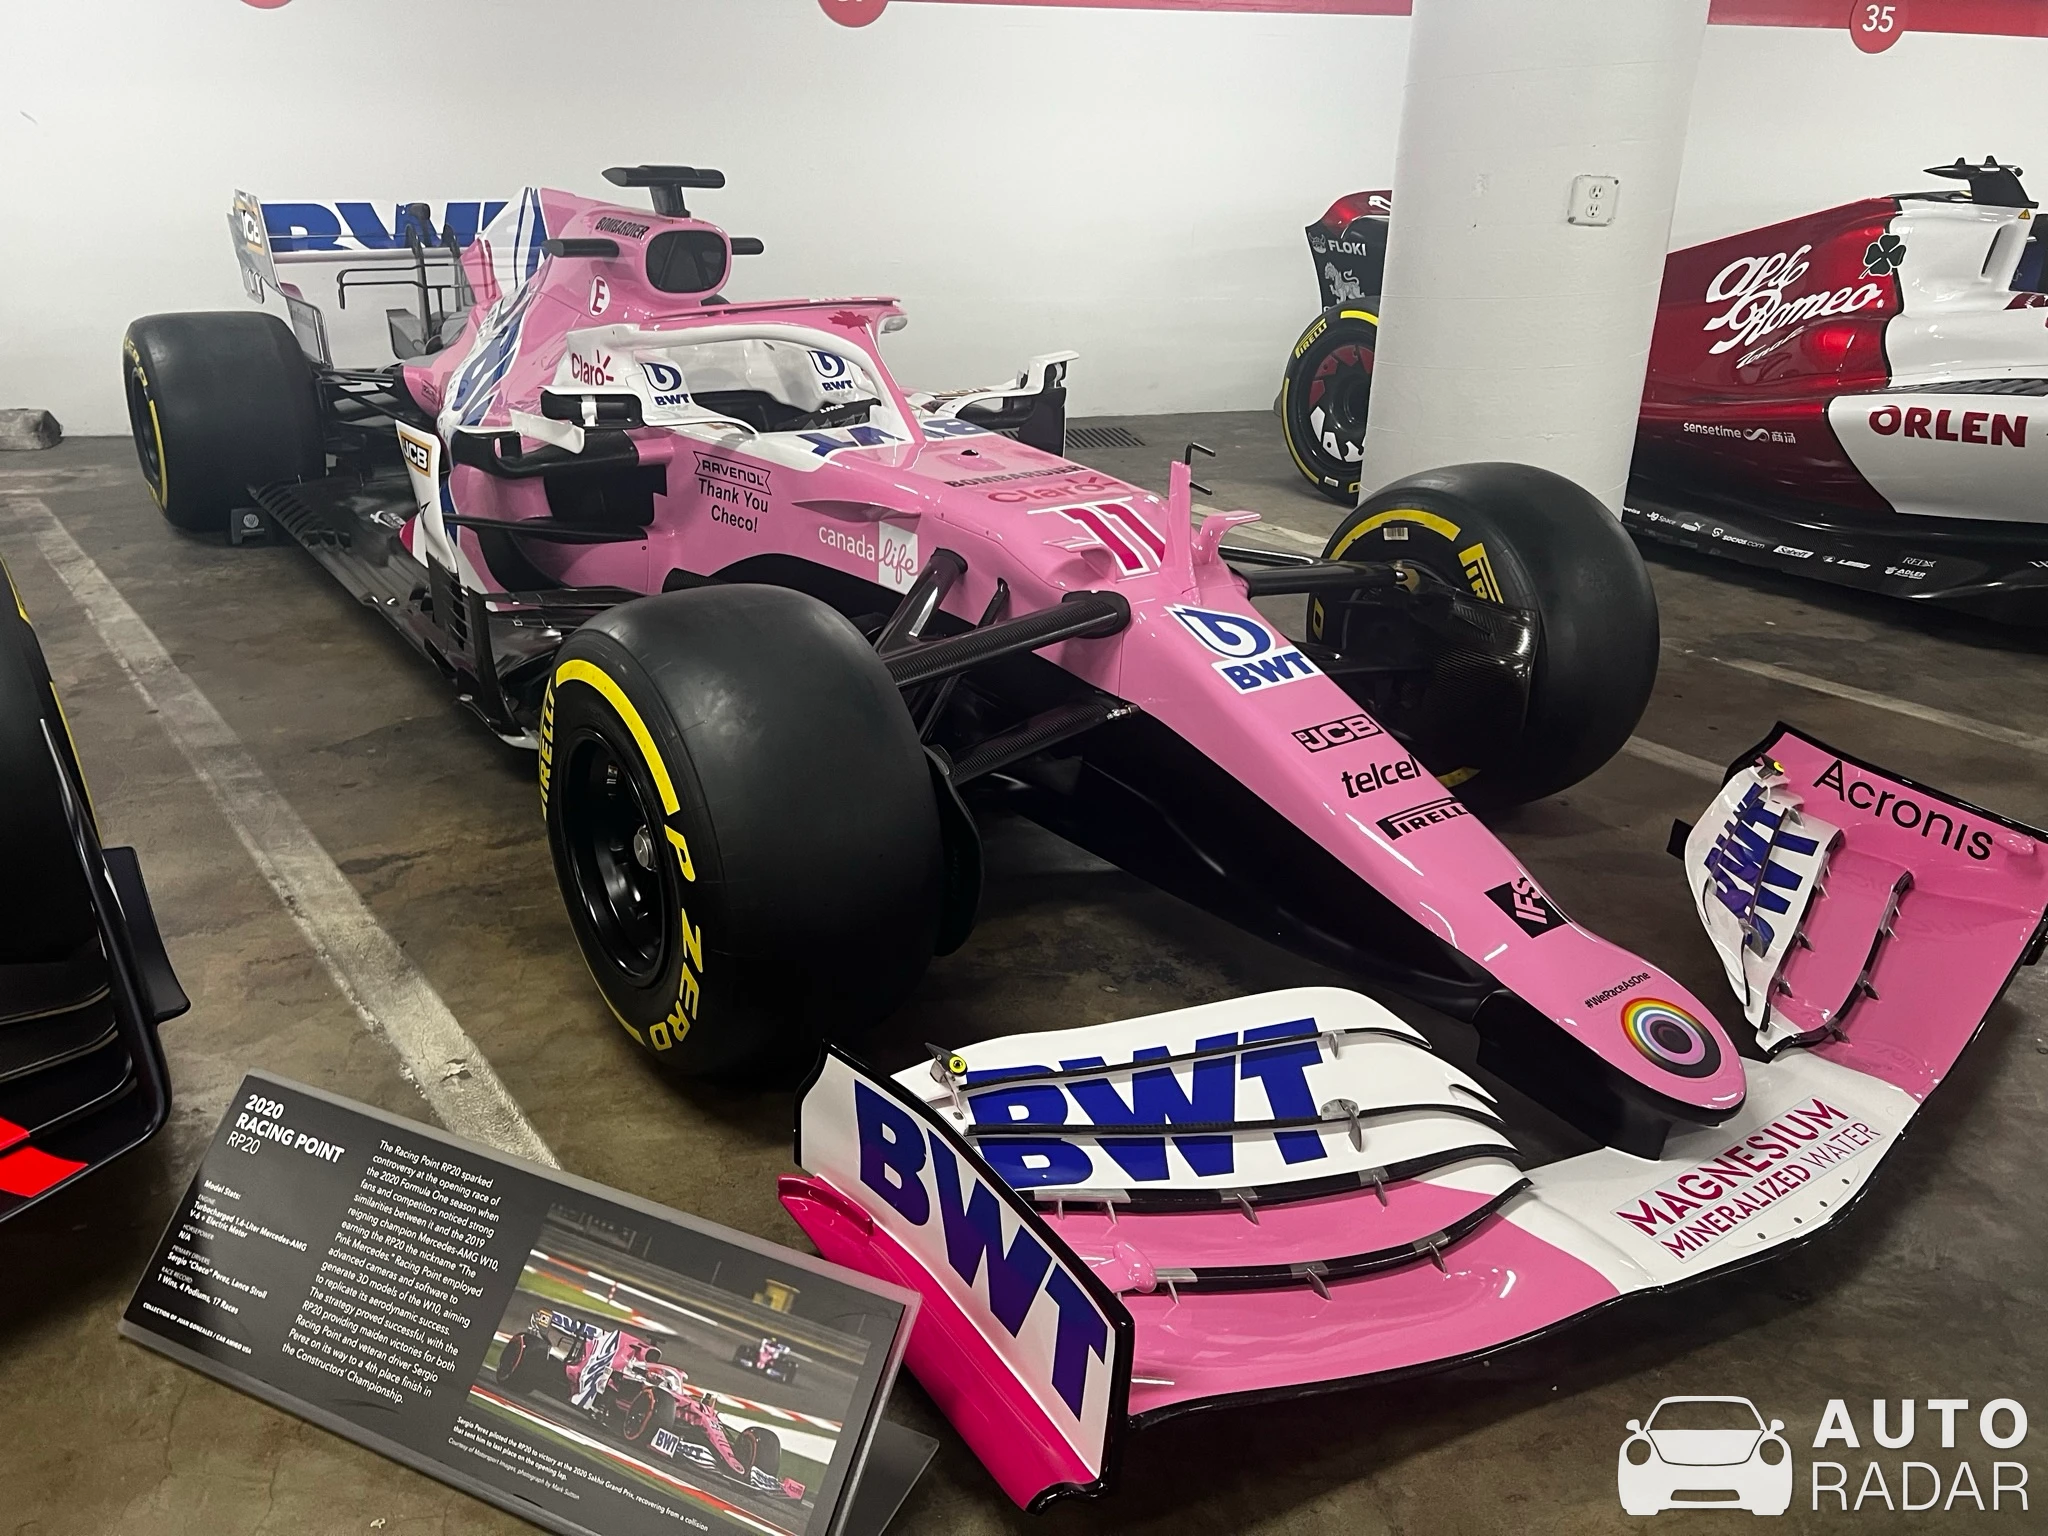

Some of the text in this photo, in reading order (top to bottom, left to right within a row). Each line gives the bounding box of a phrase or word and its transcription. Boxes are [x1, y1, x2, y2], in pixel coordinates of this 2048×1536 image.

[1862, 4, 1896, 33] 35
[261, 202, 508, 252] BW
[595, 216, 650, 240] BOMBARDIER
[1327, 239, 1367, 257] FLOKI
[592, 279, 606, 313] E
[1295, 318, 1328, 359] PIRELLI
[571, 352, 614, 386] Claro
[822, 380, 854, 392] BWT
[654, 393, 689, 406] BWT
[1683, 421, 1742, 440] sensetime
[1868, 404, 2029, 448] ORLEN
[403, 440, 429, 470] JCB
[702, 458, 765, 487] RAVENOL
[945, 464, 1088, 487] BOMBARDIER
[699, 479, 769, 513] Thank You
[711, 504, 758, 533] Checo!
[819, 526, 919, 585] canada life
[1058, 503, 1167, 576] 11
[1898, 568, 1927, 578] ADLER
[1222, 651, 1315, 691] BWT
[539, 678, 556, 821] PIRELLI
[1301, 716, 1380, 751] JCB
[1341, 754, 1422, 799] telcel
[1812, 759, 1995, 861] Acronis
[1512, 876, 1548, 925] IFS
[650, 824, 703, 1051] P ZERO
[1585, 972, 1651, 1009] #WeRaceAsOne
[244, 1094, 284, 1119] 2020
[960, 1016, 1332, 1189] BWT
[226, 1130, 260, 1155] RP20
[235, 1112, 345, 1163] RACING POINT
[372, 1155, 501, 1206] controversy at the opening race of
[379, 1139, 494, 1188] The Racing Point RP20 sparked
[1616, 1098, 1849, 1237] MAGNESIUM
[203, 1179, 241, 1200] Model Stats:
[360, 1178, 495, 1239] fans and competitors noticed strong
[366, 1166, 499, 1222] the 2020 Formula One season when
[1660, 1122, 1880, 1259] MINERALIZED WATER
[347, 1207, 499, 1272] reigning champion Mercedes-AMG W10,
[353, 1193, 485, 1248] similarities between it and the 2019
[334, 1231, 352, 1246] Pink
[394, 1254, 421, 1275] Racing
[421, 1265, 442, 1281] Point
[442, 1276, 484, 1297] employed
[341, 1220, 370, 1239] earning
[370, 1230, 384, 1243] the
[384, 1234, 406, 1250] RP20
[404, 1243, 418, 1256] the
[418, 1250, 456, 1271] nickname
[854, 1079, 1110, 1423] BWT
[167, 1251, 187, 1266] Sergio
[211, 1270, 230, 1285] Perez,
[230, 1277, 250, 1292] Lance
[249, 1285, 268, 1299] Stroll
[320, 1261, 471, 1329] generate 3D models of the W10, aiming
[327, 1247, 458, 1304] advanced cameras and software to
[309, 1285, 459, 1356] The strategy proved successful, with the
[315, 1273, 450, 1336] to replicate its aerodynamic success.
[295, 1313, 438, 1382] Racing Point and veteran driver Sergio
[301, 1299, 455, 1372] RP20 providing maiden victories for both
[281, 1342, 295, 1355] the
[346, 1370, 403, 1404] Championship.
[288, 1327, 432, 1397] Perez on its way to a 4th place finish in
[656, 1430, 679, 1453] BWT
